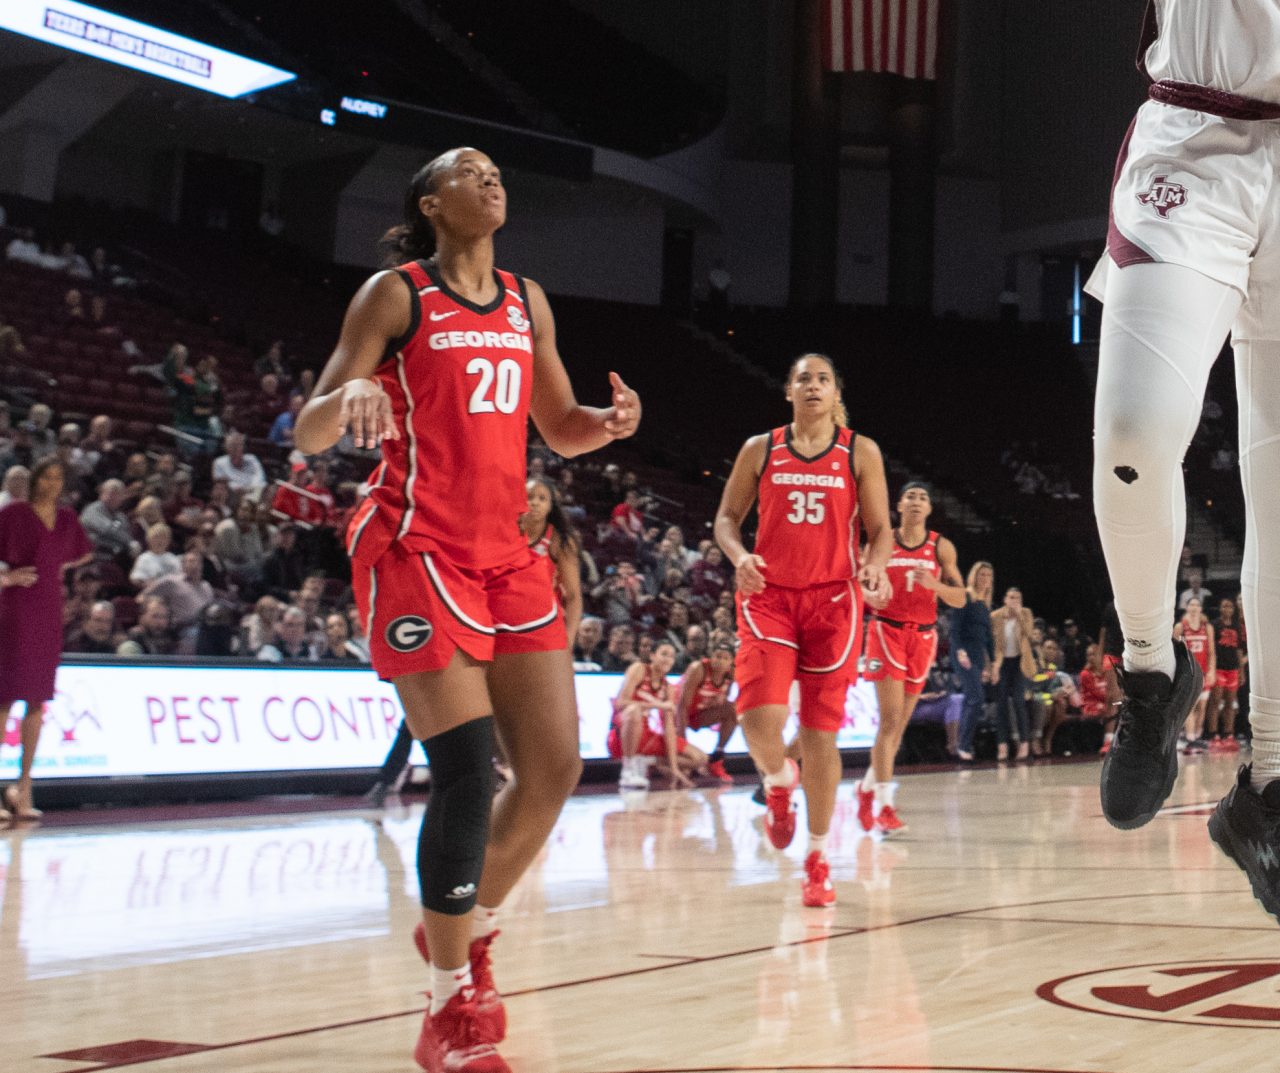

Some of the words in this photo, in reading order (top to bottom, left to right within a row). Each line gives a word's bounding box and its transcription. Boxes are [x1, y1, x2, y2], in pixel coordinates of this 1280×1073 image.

[429, 330, 533, 354] GEORGIA
[466, 357, 521, 414] 20
[771, 472, 845, 489] GEORGIA
[787, 491, 826, 524] 35
[146, 696, 240, 744] PEST
[263, 696, 399, 742] CONTR
